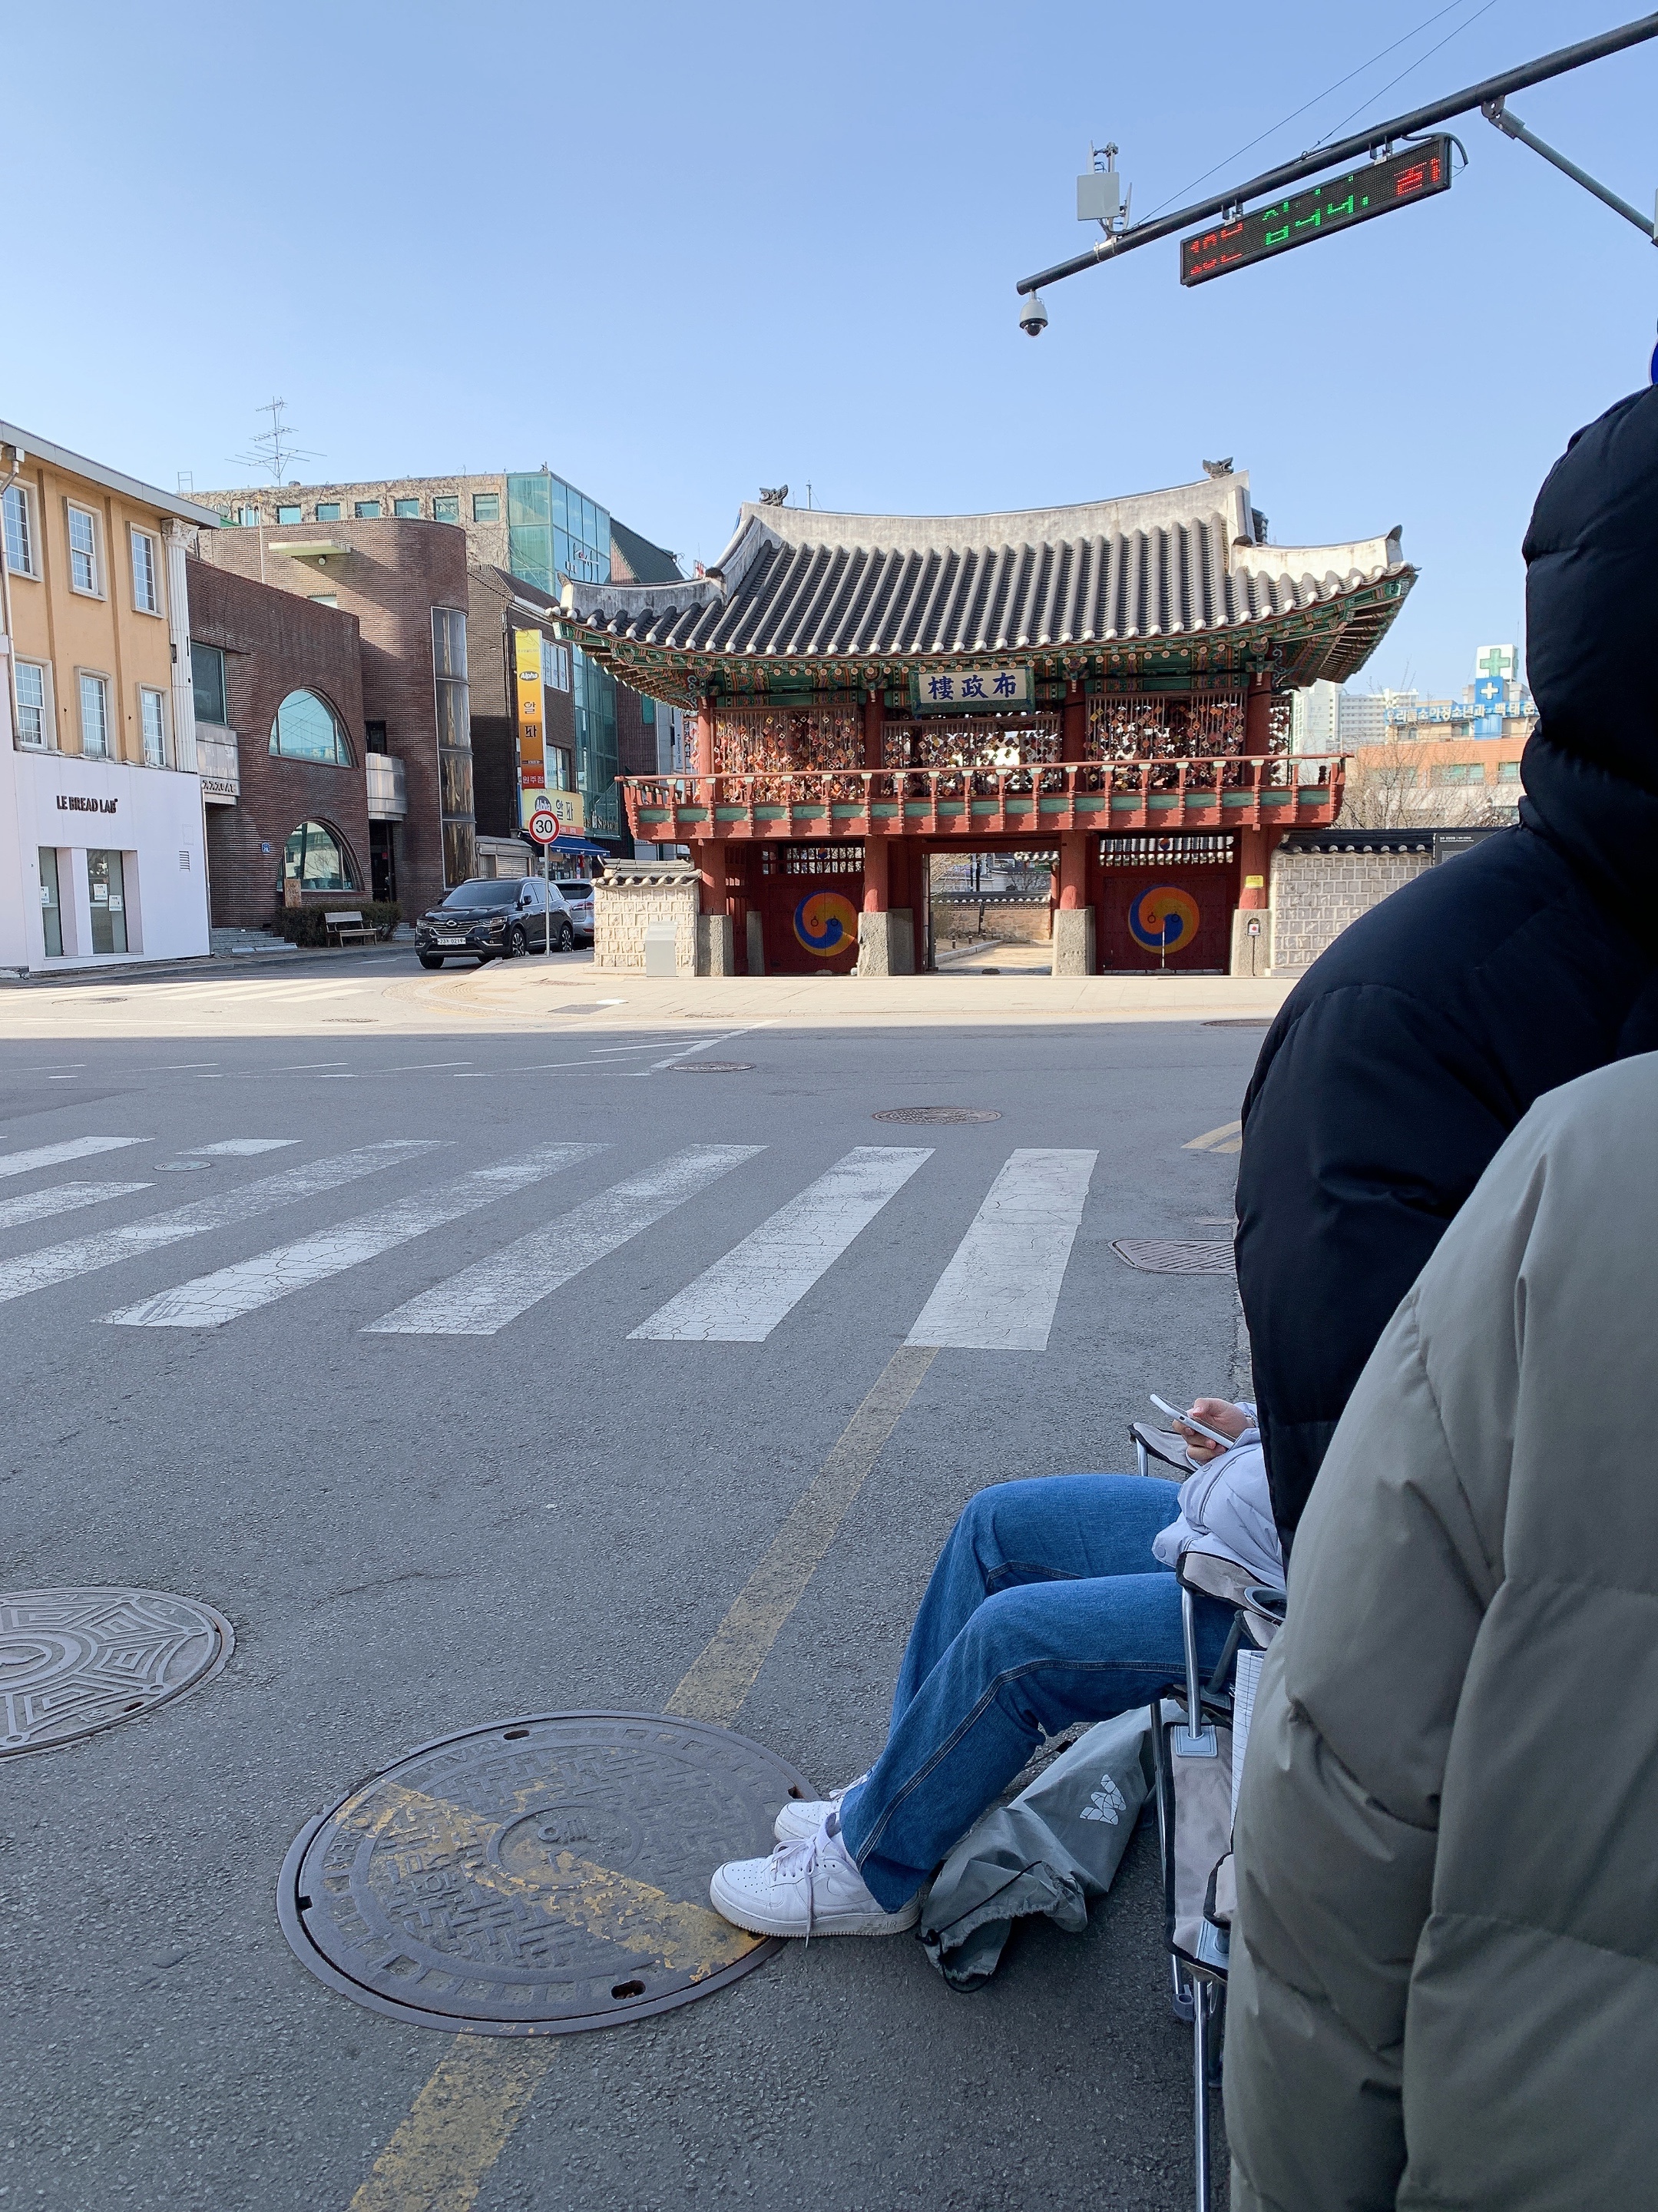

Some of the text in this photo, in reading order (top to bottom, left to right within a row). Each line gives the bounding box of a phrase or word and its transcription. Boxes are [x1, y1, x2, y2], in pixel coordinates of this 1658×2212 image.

[520, 671, 538, 680] Alpha
[56, 796, 68, 810] LE
[68, 796, 98, 812] BREAD
[535, 820, 553, 833] 30
